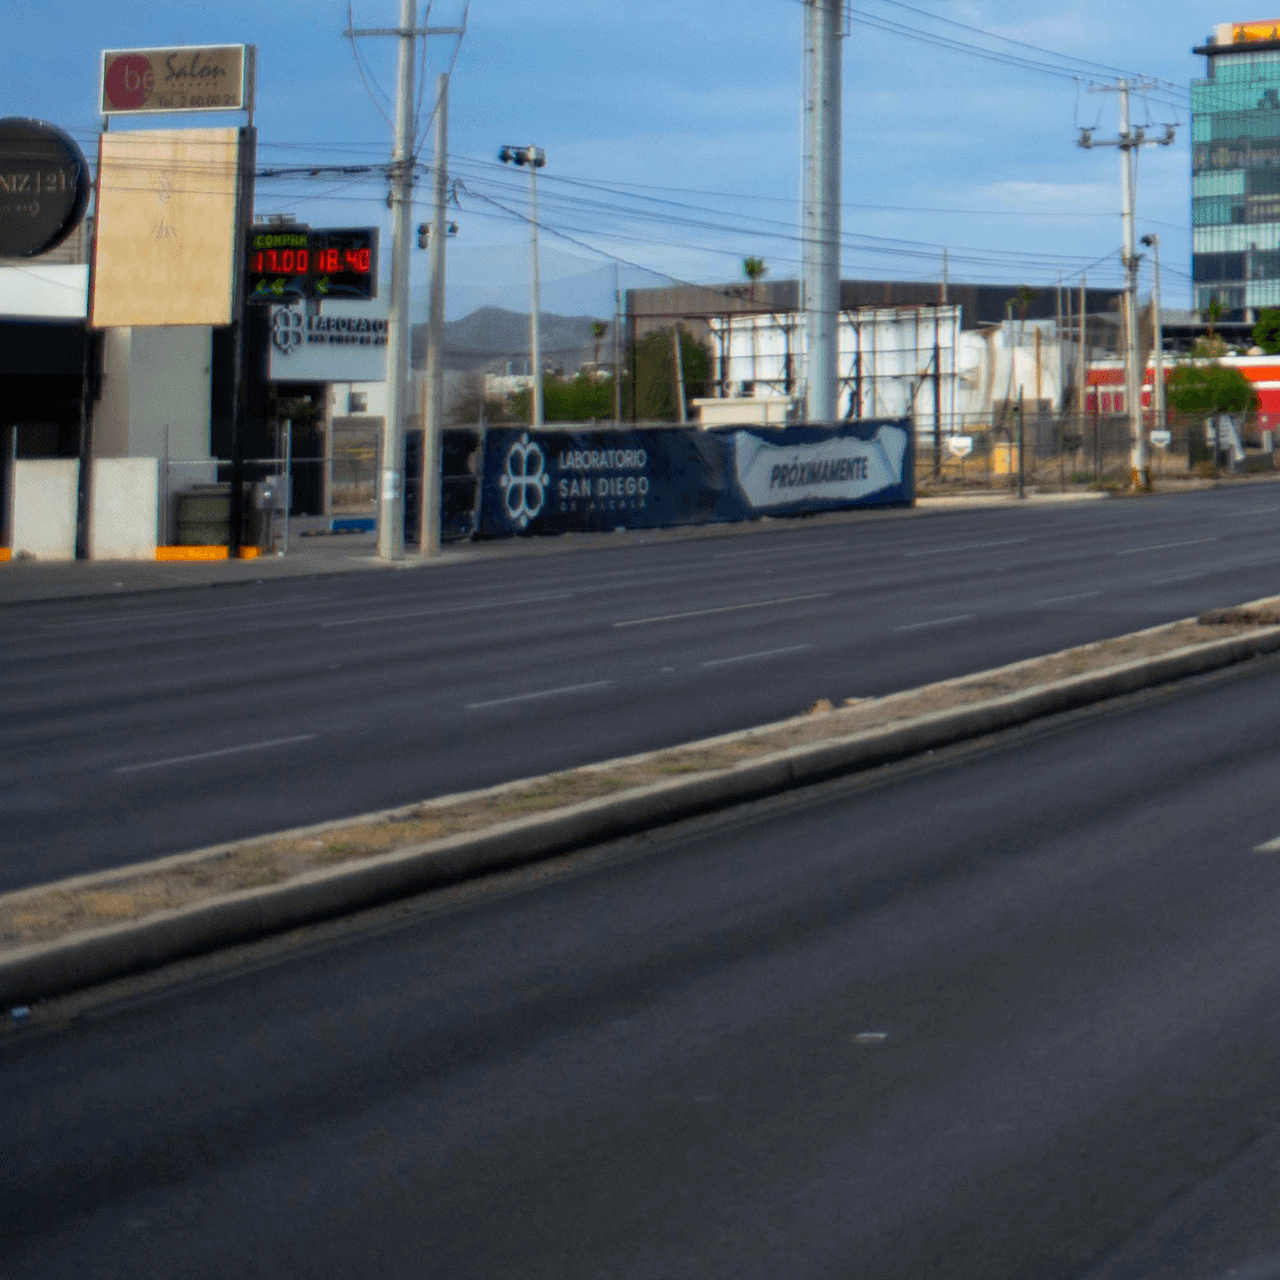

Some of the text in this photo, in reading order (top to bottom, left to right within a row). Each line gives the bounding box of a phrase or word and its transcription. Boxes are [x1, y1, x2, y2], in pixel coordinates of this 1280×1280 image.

[124, 64, 155, 91] be
[307, 317, 388, 332] LABORATO
[559, 449, 648, 470] LABORATORIO
[770, 456, 869, 489] PRÓXIMAMENTE
[558, 476, 650, 498] SAN DIEGO
